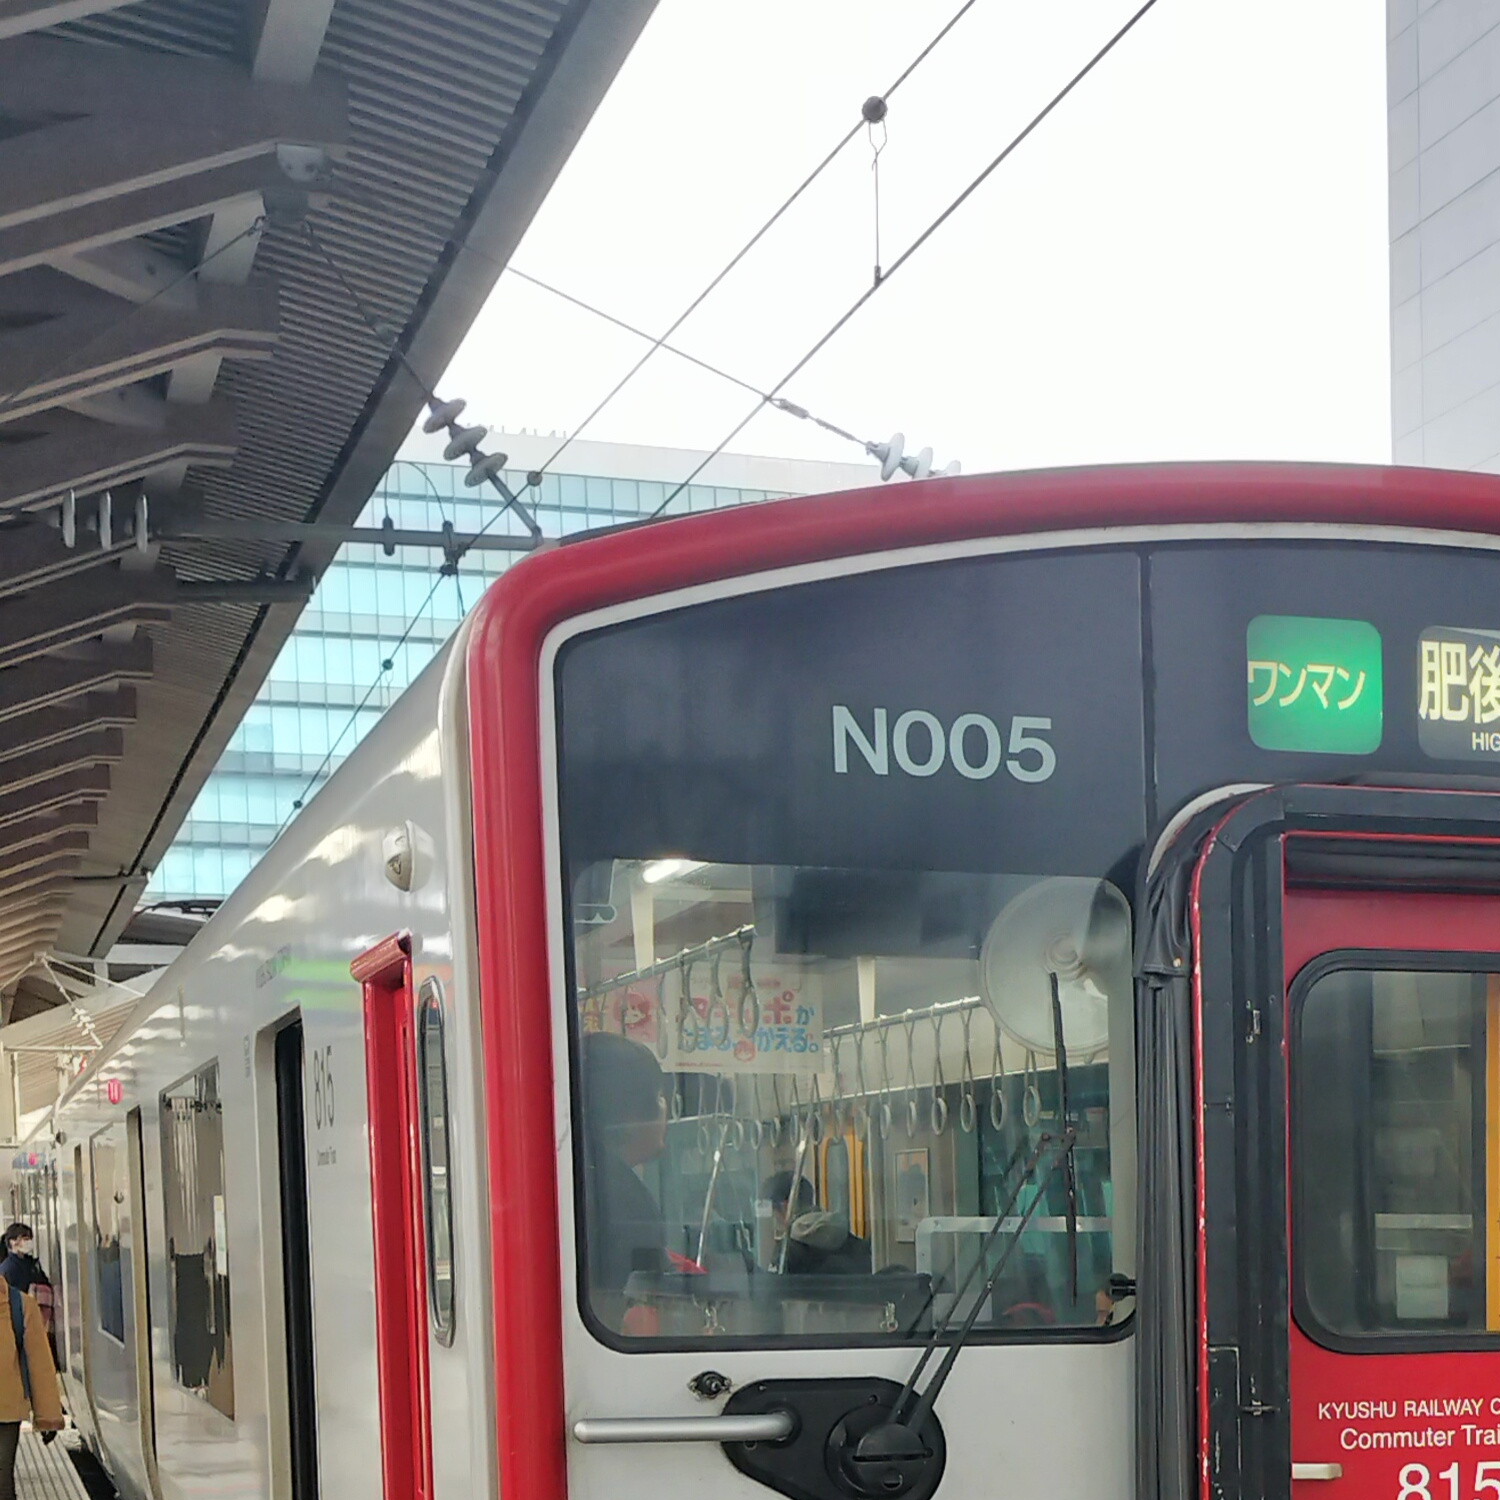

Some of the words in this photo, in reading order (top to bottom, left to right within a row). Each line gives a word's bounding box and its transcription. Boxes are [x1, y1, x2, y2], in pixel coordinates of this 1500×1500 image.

[1247, 660, 1366, 711] ワンマン
[832, 705, 1057, 784] N005
[314, 1045, 335, 1130] 815
[1318, 1400, 1397, 1420] KYUSHU
[1403, 1397, 1484, 1418] RAILWAY
[1340, 1427, 1456, 1450] Commuter
